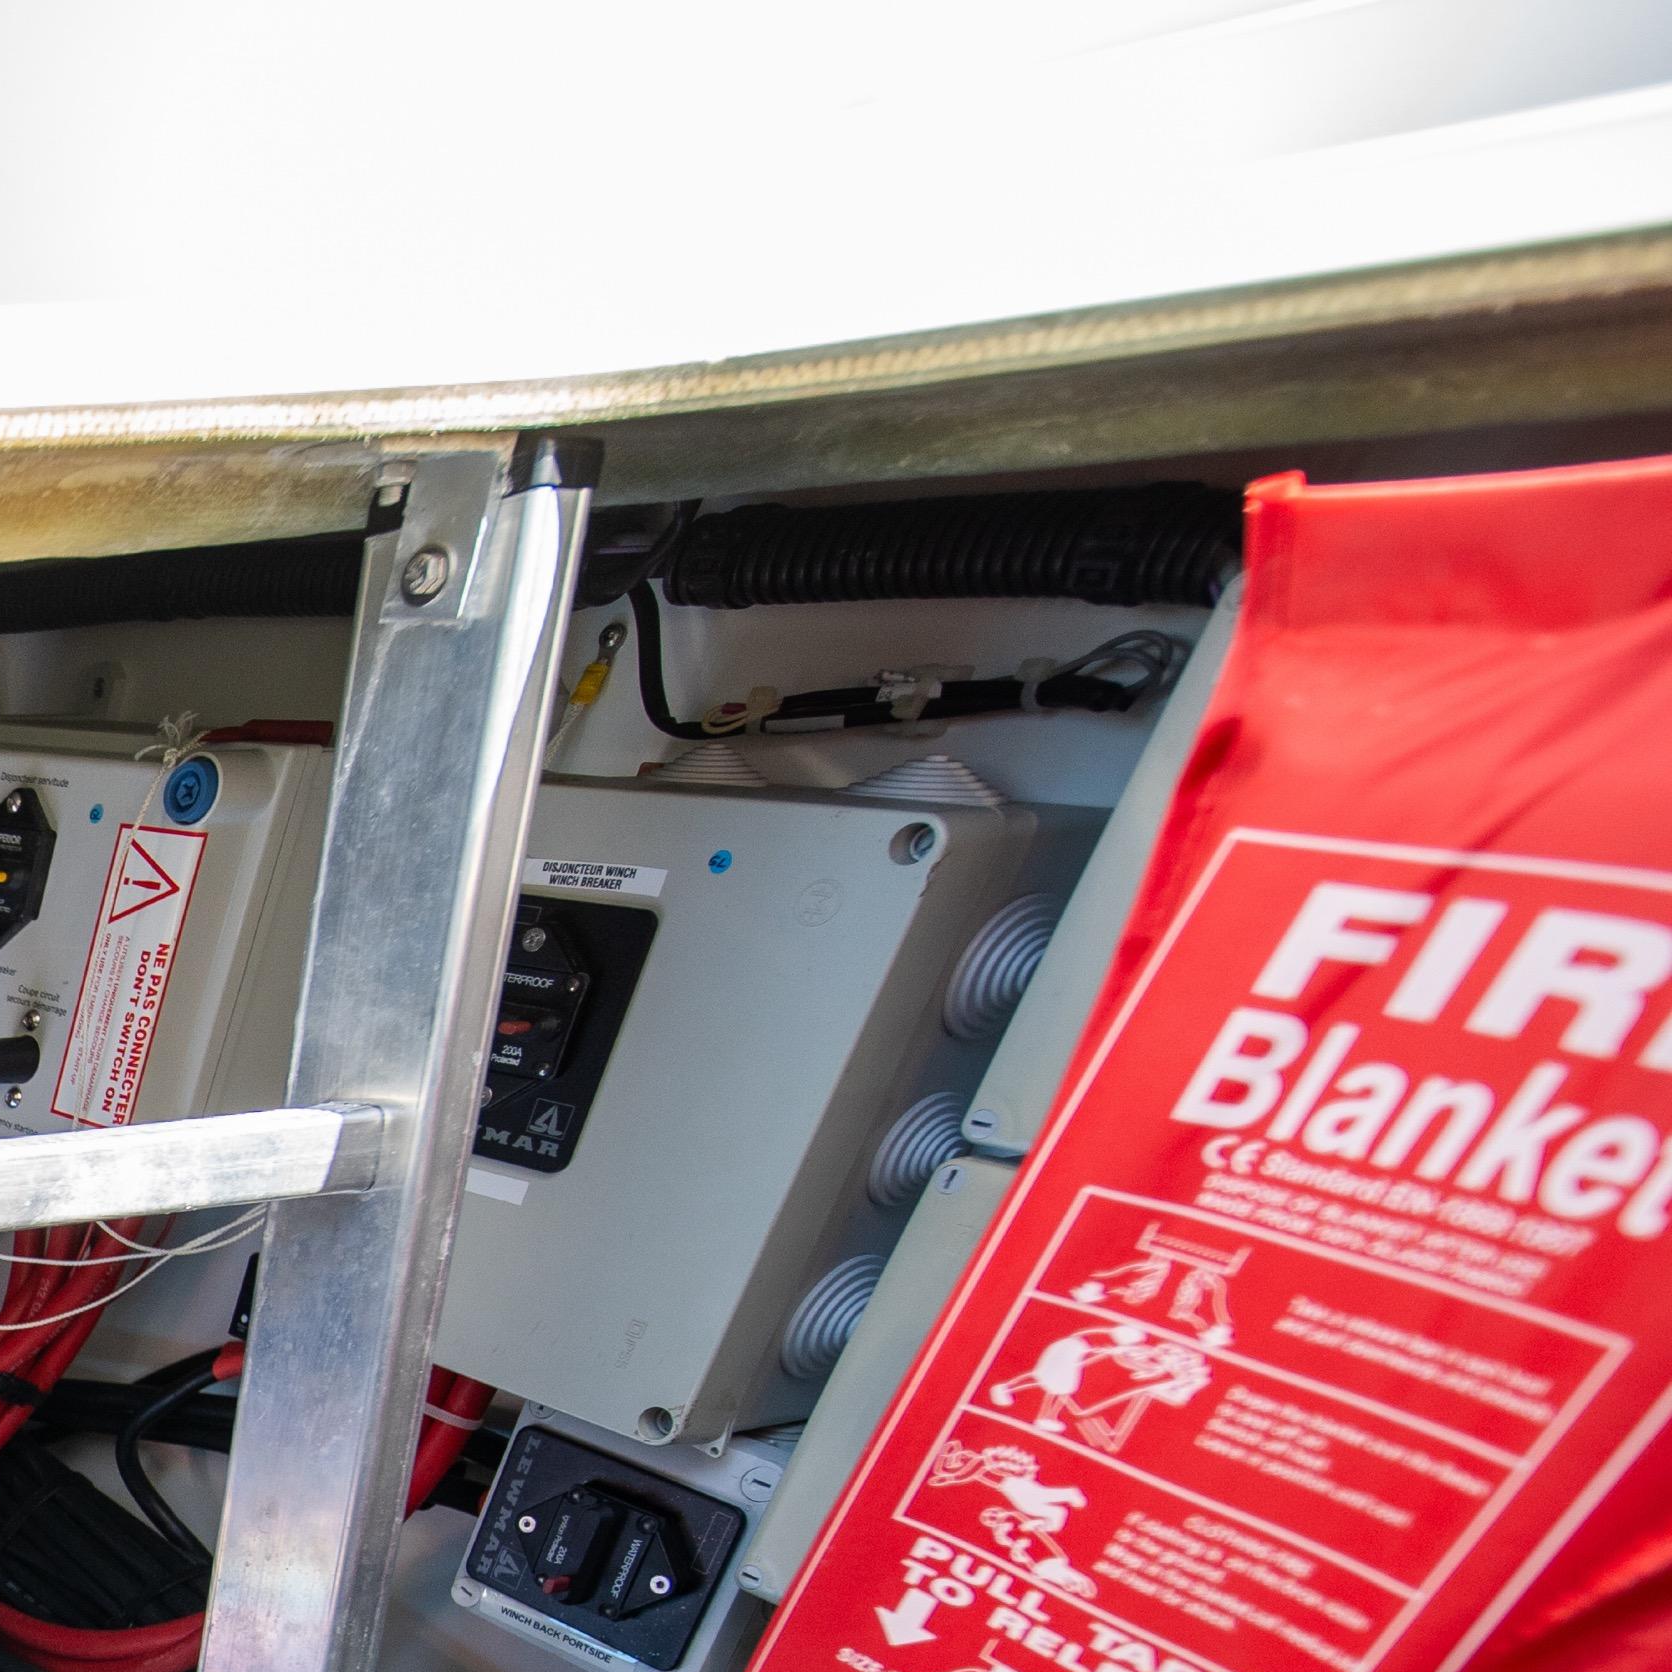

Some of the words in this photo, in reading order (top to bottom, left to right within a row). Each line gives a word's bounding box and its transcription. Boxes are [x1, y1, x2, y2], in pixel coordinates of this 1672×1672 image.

[0, 772, 38, 785] Disjoncteur
[39, 776, 70, 788] servitude
[543, 862, 604, 876] DISJONCTEUR
[605, 866, 637, 879] WINCH
[549, 874, 580, 886] WINCH
[581, 877, 622, 890] BREAKER
[153, 943, 170, 969] NE
[18, 984, 38, 998] Coupe
[39, 990, 60, 1003] circuit
[129, 950, 151, 1006] DON'T
[142, 974, 162, 1010] PAS
[503, 973, 554, 988] TERPROOF
[1250, 881, 1672, 1072] FIR
[7, 995, 31, 1008] secours
[109, 1011, 135, 1082] SWITCH
[501, 1044, 522, 1057] 200A
[112, 1016, 151, 1126] CONNECTER
[102, 1087, 115, 1112] ON
[480, 1125, 559, 1158] MAR
[476, 1436, 541, 1575] LEWMAR
[610, 1538, 643, 1599] WATERPROOF
[901, 1557, 975, 1608] TO
[909, 1536, 1051, 1624] PULL
[501, 1605, 532, 1628] WINCH
[532, 1620, 561, 1640] BACK
[562, 1634, 612, 1664] PORTSIDE
